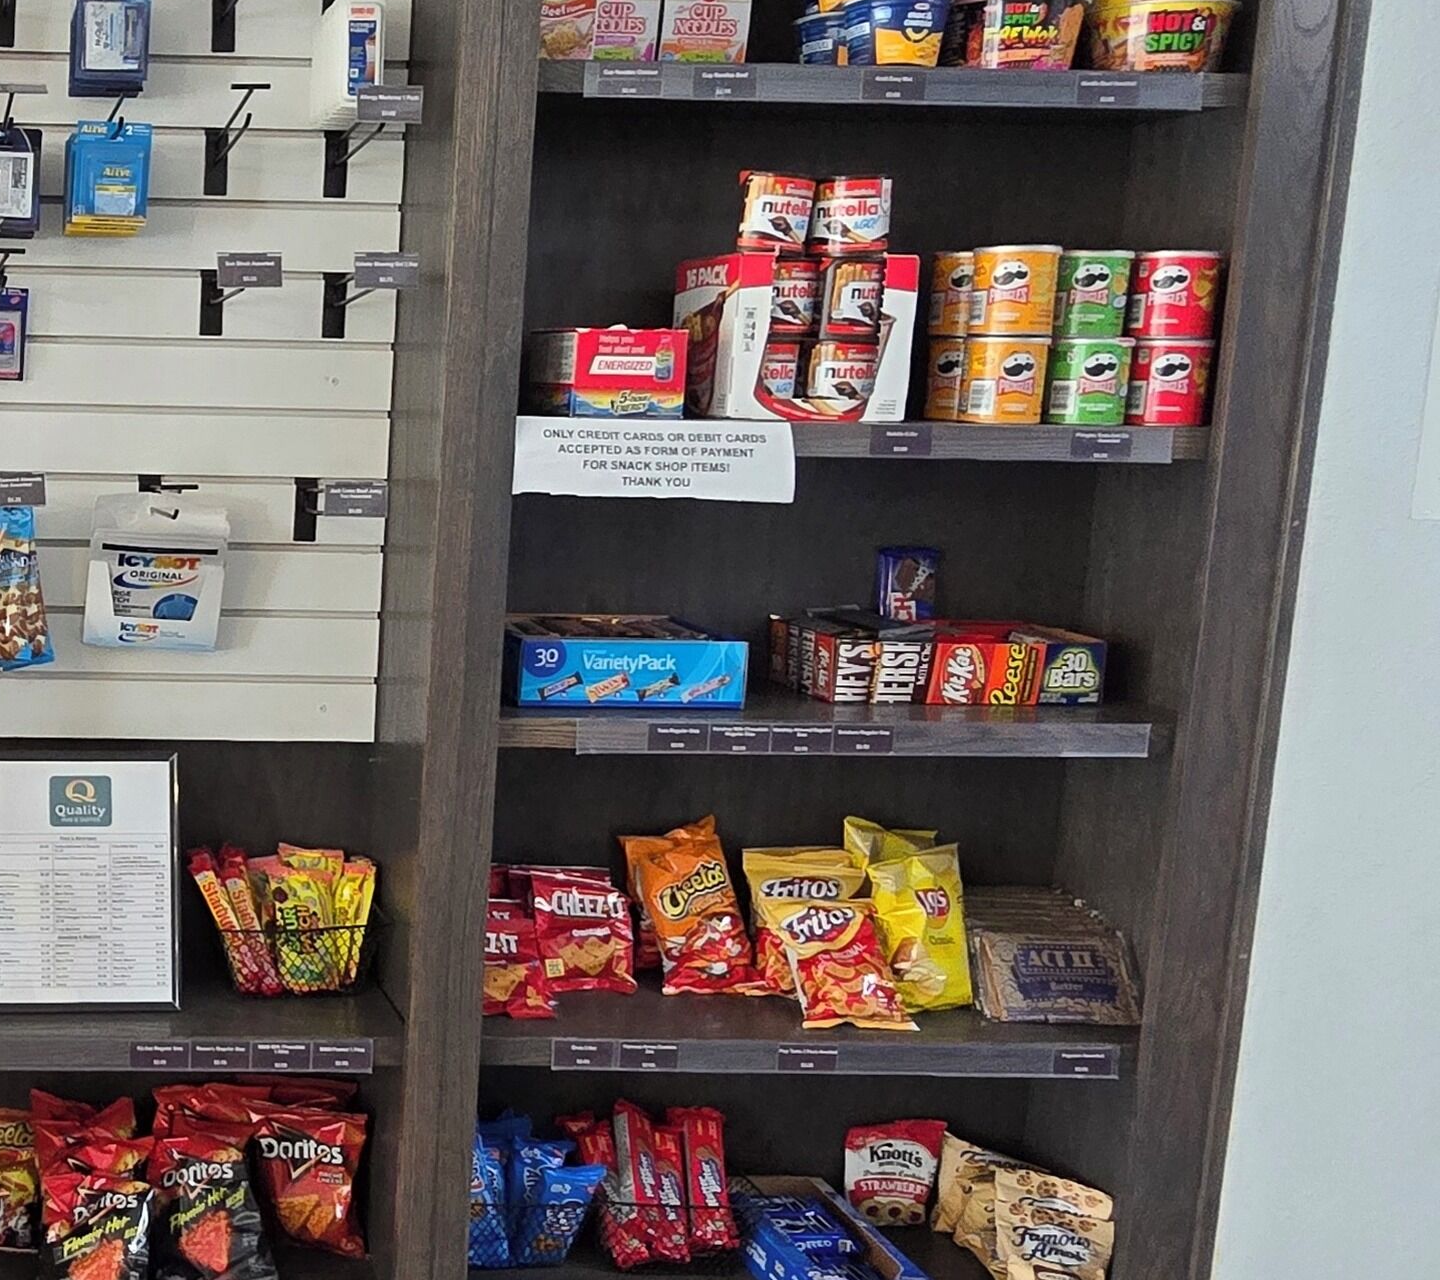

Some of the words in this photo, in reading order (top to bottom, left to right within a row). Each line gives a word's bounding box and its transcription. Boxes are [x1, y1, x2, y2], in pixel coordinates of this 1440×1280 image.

[541, 5, 566, 16] Beef
[600, 2, 635, 19] CUP
[689, 3, 727, 20] CUP
[673, 18, 738, 36] NOODLES
[1144, 32, 1205, 52] SPICY
[817, 198, 878, 218] nutella
[698, 263, 729, 286] PACK
[597, 360, 654, 371] ENERGIZED
[543, 428, 574, 440] ONLY
[578, 429, 620, 441] CREDIT
[623, 430, 665, 442] CARDS
[667, 431, 685, 442] OR
[688, 432, 722, 443] DEBIT
[725, 432, 767, 444] CARDS
[558, 444, 622, 456] ACCEPTED
[625, 445, 642, 455] AS
[644, 446, 679, 456] FORM
[681, 446, 698, 457] OF
[700, 447, 755, 458] PAYMENT
[582, 459, 608, 470] FOR
[610, 460, 652, 471] SNACK
[655, 461, 689, 472] SHOP
[691, 462, 731, 473] ITEMS!
[622, 476, 663, 487] THANK
[665, 477, 691, 488] YOU
[130, 570, 183, 581] ORIGINAL
[534, 648, 560, 668] 30
[1062, 651, 1089, 670] 30
[1049, 668, 1098, 689] Bars
[65, 779, 97, 803] Q
[55, 804, 106, 817] Quality
[659, 862, 728, 918] Cheetos
[761, 876, 841, 899] Fritos
[779, 905, 857, 945] Fritos
[1027, 950, 1065, 968] ACT
[1072, 950, 1096, 968] II
[259, 1136, 344, 1165] Doritos
[868, 1142, 923, 1168] Knott's
[163, 1163, 234, 1187] Doritos
[859, 1180, 929, 1195] STRAWBERRY
[73, 1192, 139, 1225] Doritos
[1011, 1225, 1092, 1249] Famous
[1021, 1242, 1088, 1262] Amos
